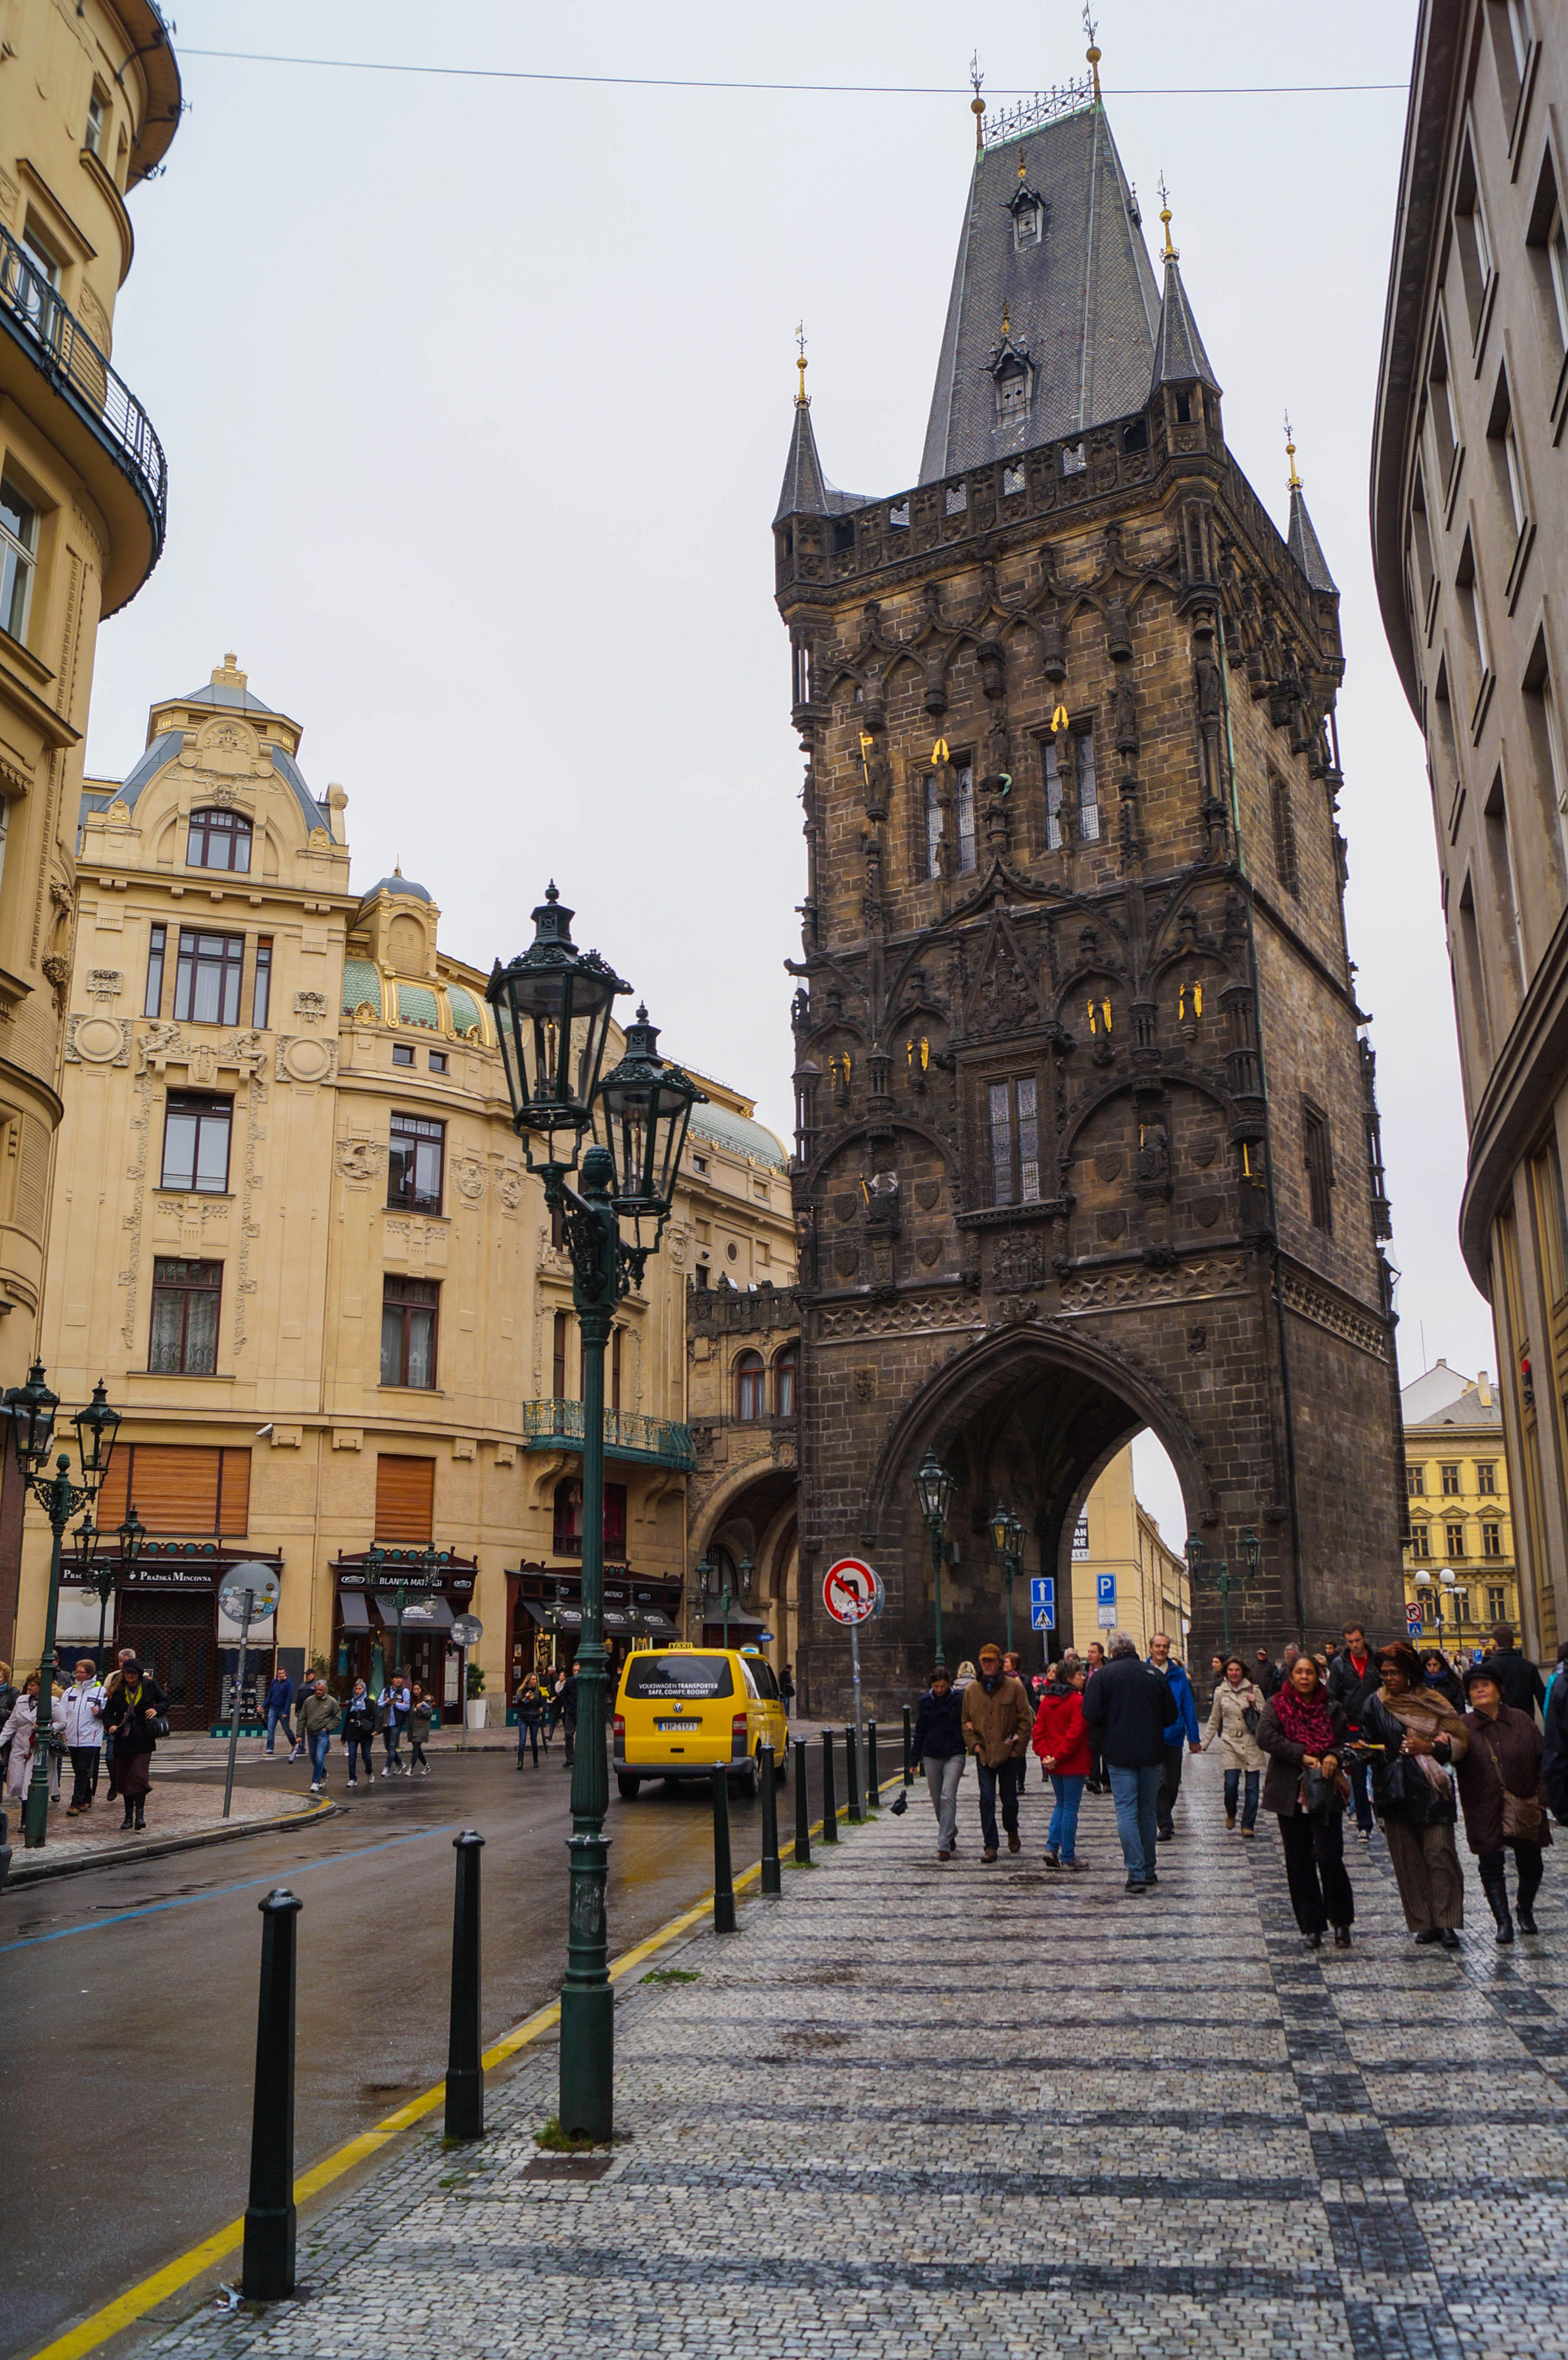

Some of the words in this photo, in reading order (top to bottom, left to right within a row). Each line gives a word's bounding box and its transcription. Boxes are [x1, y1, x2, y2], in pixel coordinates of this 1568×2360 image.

[140, 1571, 172, 1581] PRAŽSKÁ
[173, 1572, 211, 1582] MINCOVNA
[410, 1579, 442, 1587] MATGI
[1101, 1578, 1112, 1596] P
